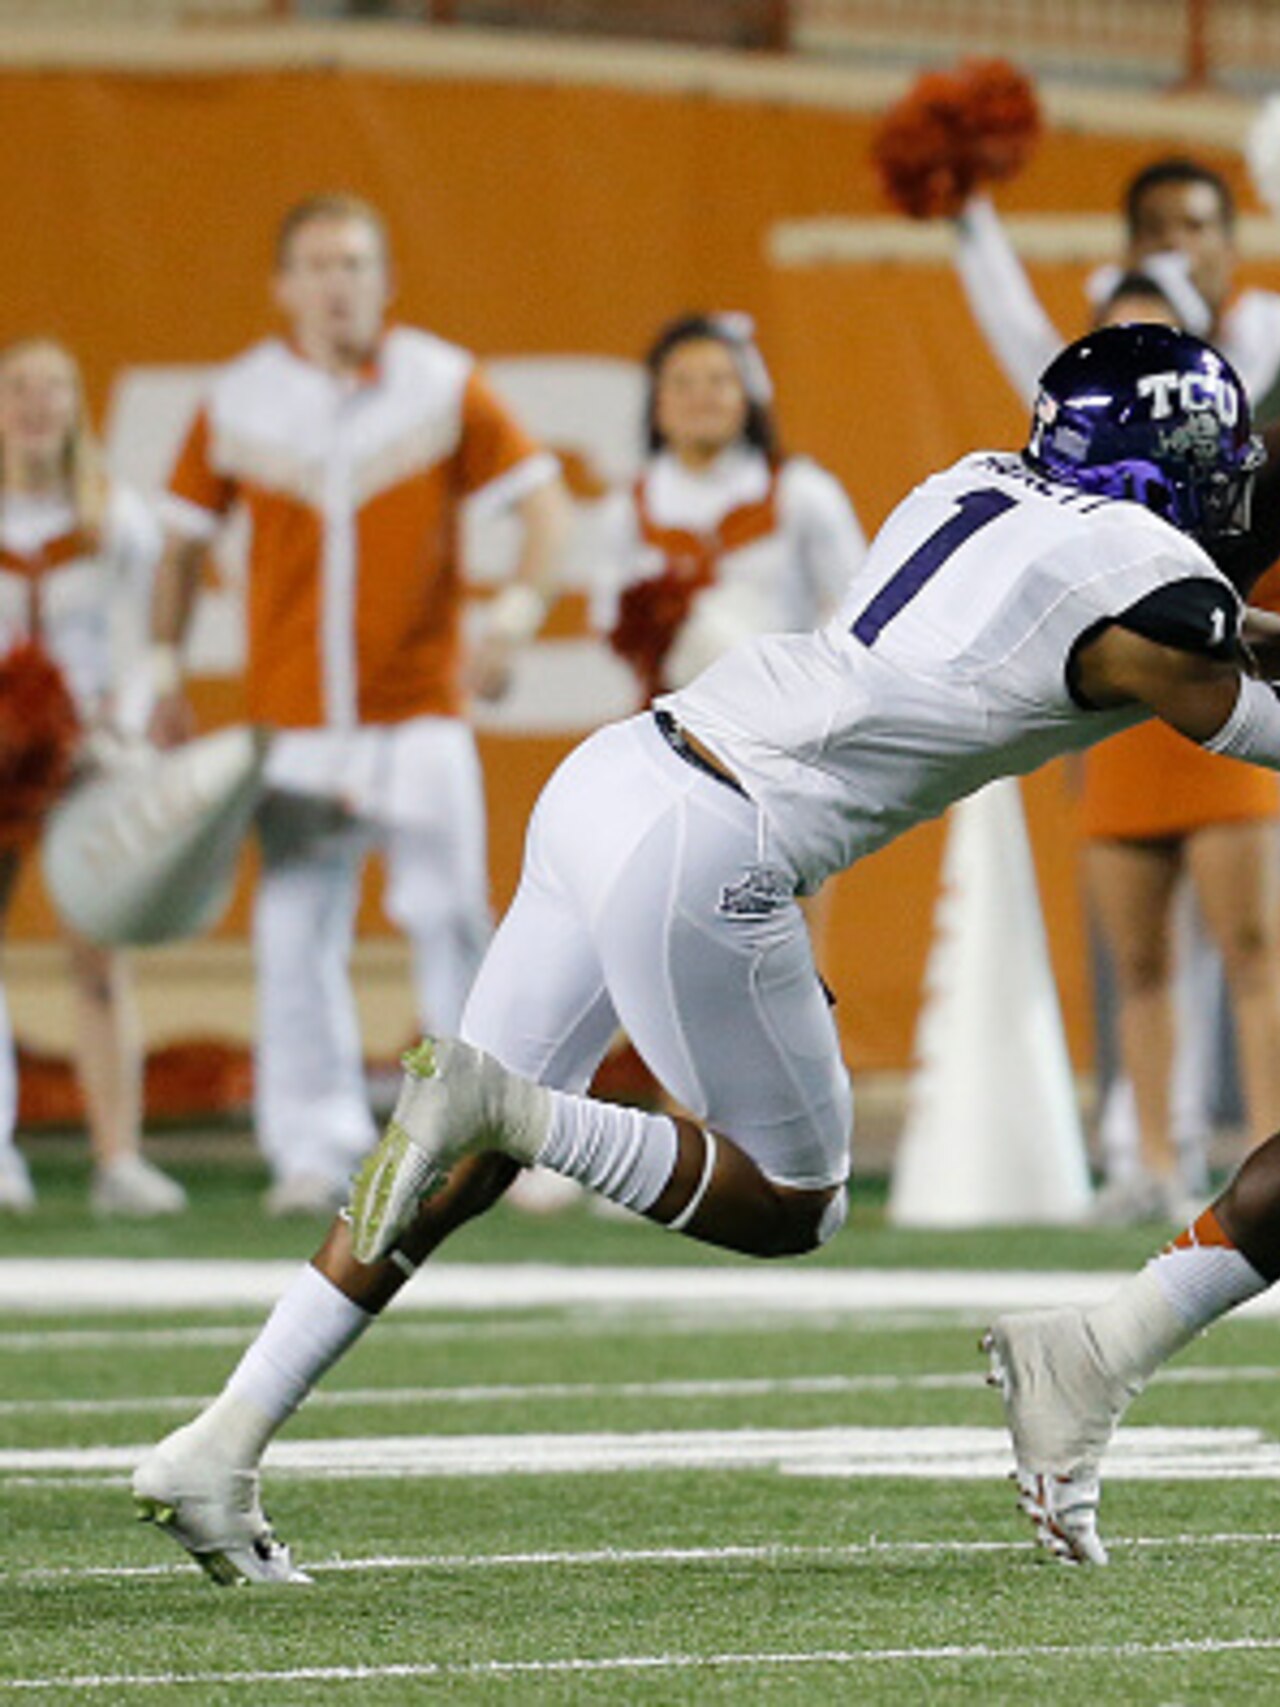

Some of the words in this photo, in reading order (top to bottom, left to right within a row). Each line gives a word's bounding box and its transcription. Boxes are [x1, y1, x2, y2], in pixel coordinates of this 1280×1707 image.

[1137, 371, 1239, 428] TCU
[852, 487, 1022, 648] 1
[1209, 606, 1226, 643] 1
